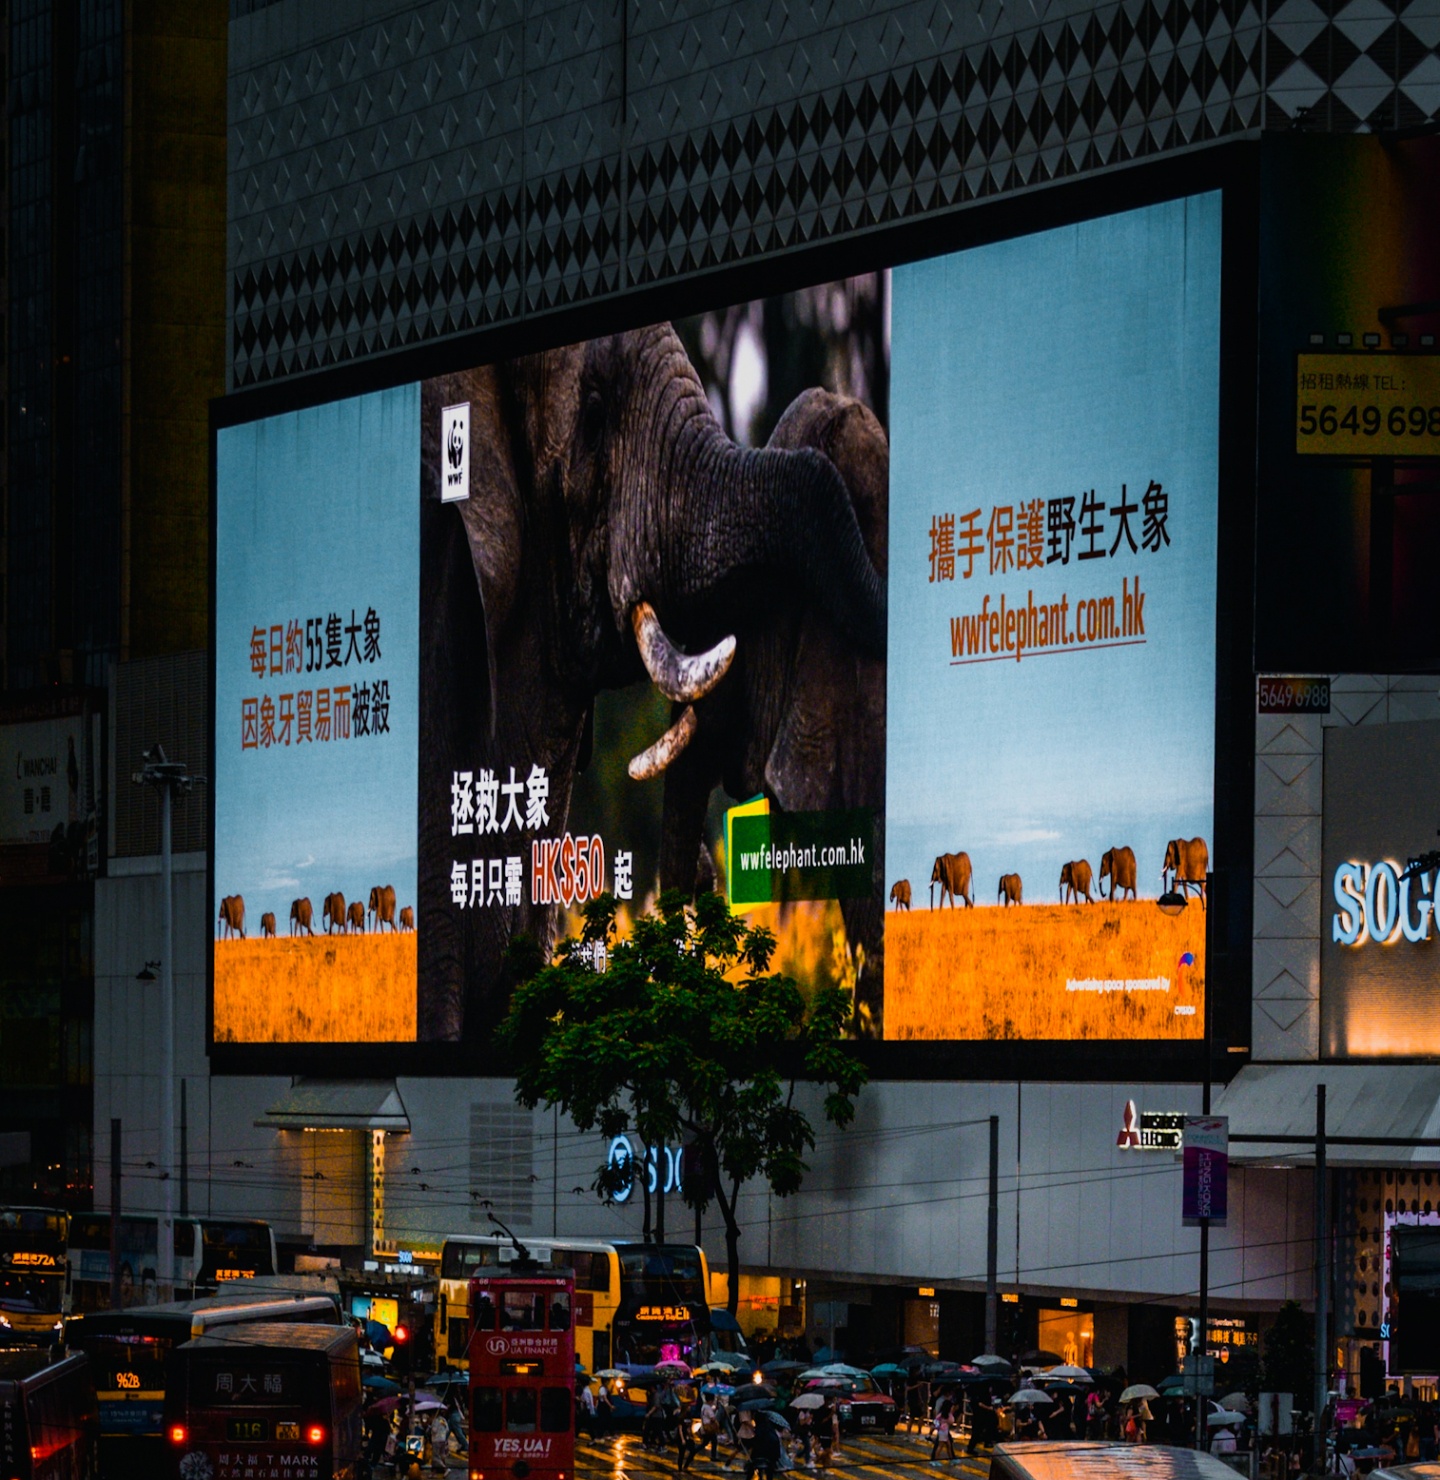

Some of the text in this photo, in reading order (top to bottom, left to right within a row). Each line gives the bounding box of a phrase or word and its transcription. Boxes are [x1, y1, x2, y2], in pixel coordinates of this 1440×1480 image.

[1300, 405, 1440, 436] 5649 698
[448, 472, 462, 486] WWF
[929, 480, 1170, 583] 攜手保護野生大象
[250, 606, 381, 679] 每日約55隻大象
[951, 576, 1145, 663] wwfelephant.com.hk
[242, 680, 390, 750] 因象牙貿易而被殺
[1260, 684, 1329, 708] 5649 6988
[451, 763, 550, 837] 拯救大象
[450, 832, 634, 909] 每月只需 HK$50 起
[740, 837, 866, 874] wwfelephant.com.hk
[1333, 861, 1440, 946] SOG
[1202, 1153, 1212, 1217] HONG KONG
[510, 1346, 558, 1355] UA FINANCE
[215, 1372, 283, 1394] 周大福
[234, 1422, 262, 1439] 116
[218, 1454, 318, 1466] 周大福 T MARK
